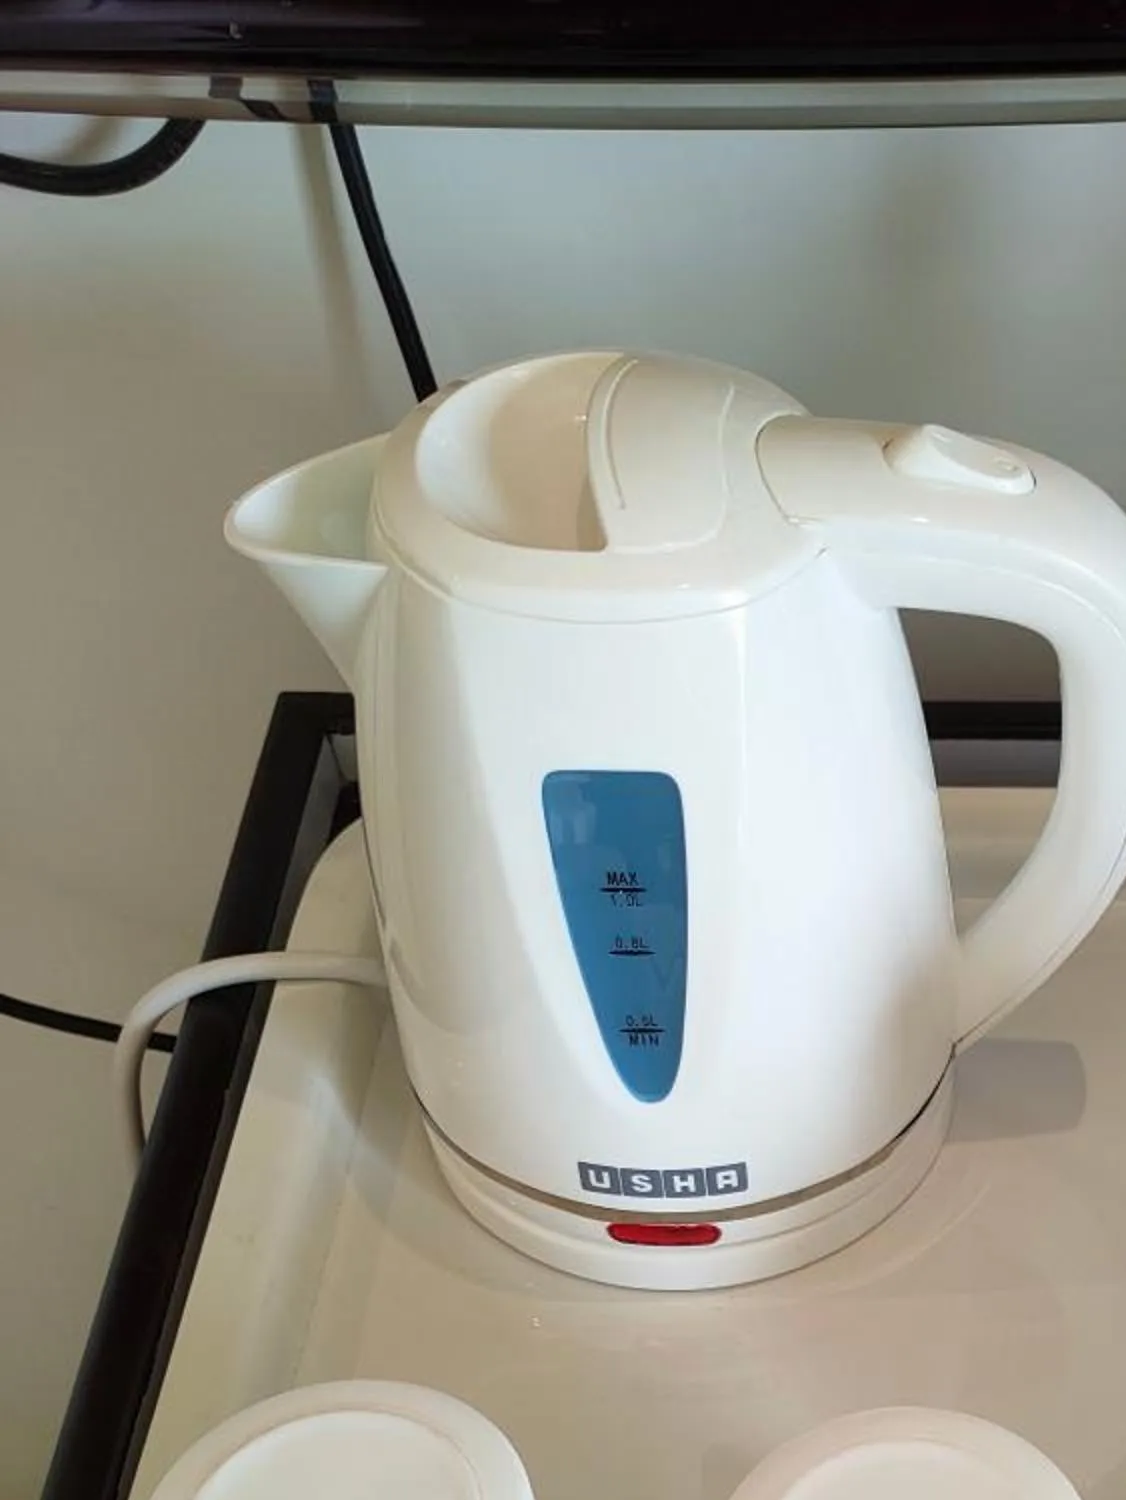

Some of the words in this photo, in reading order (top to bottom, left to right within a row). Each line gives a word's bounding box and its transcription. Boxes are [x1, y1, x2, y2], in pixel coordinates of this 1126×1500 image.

[606, 871, 640, 887] MAX
[628, 1034, 660, 1048] MIN
[584, 1166, 742, 1195] USHA
